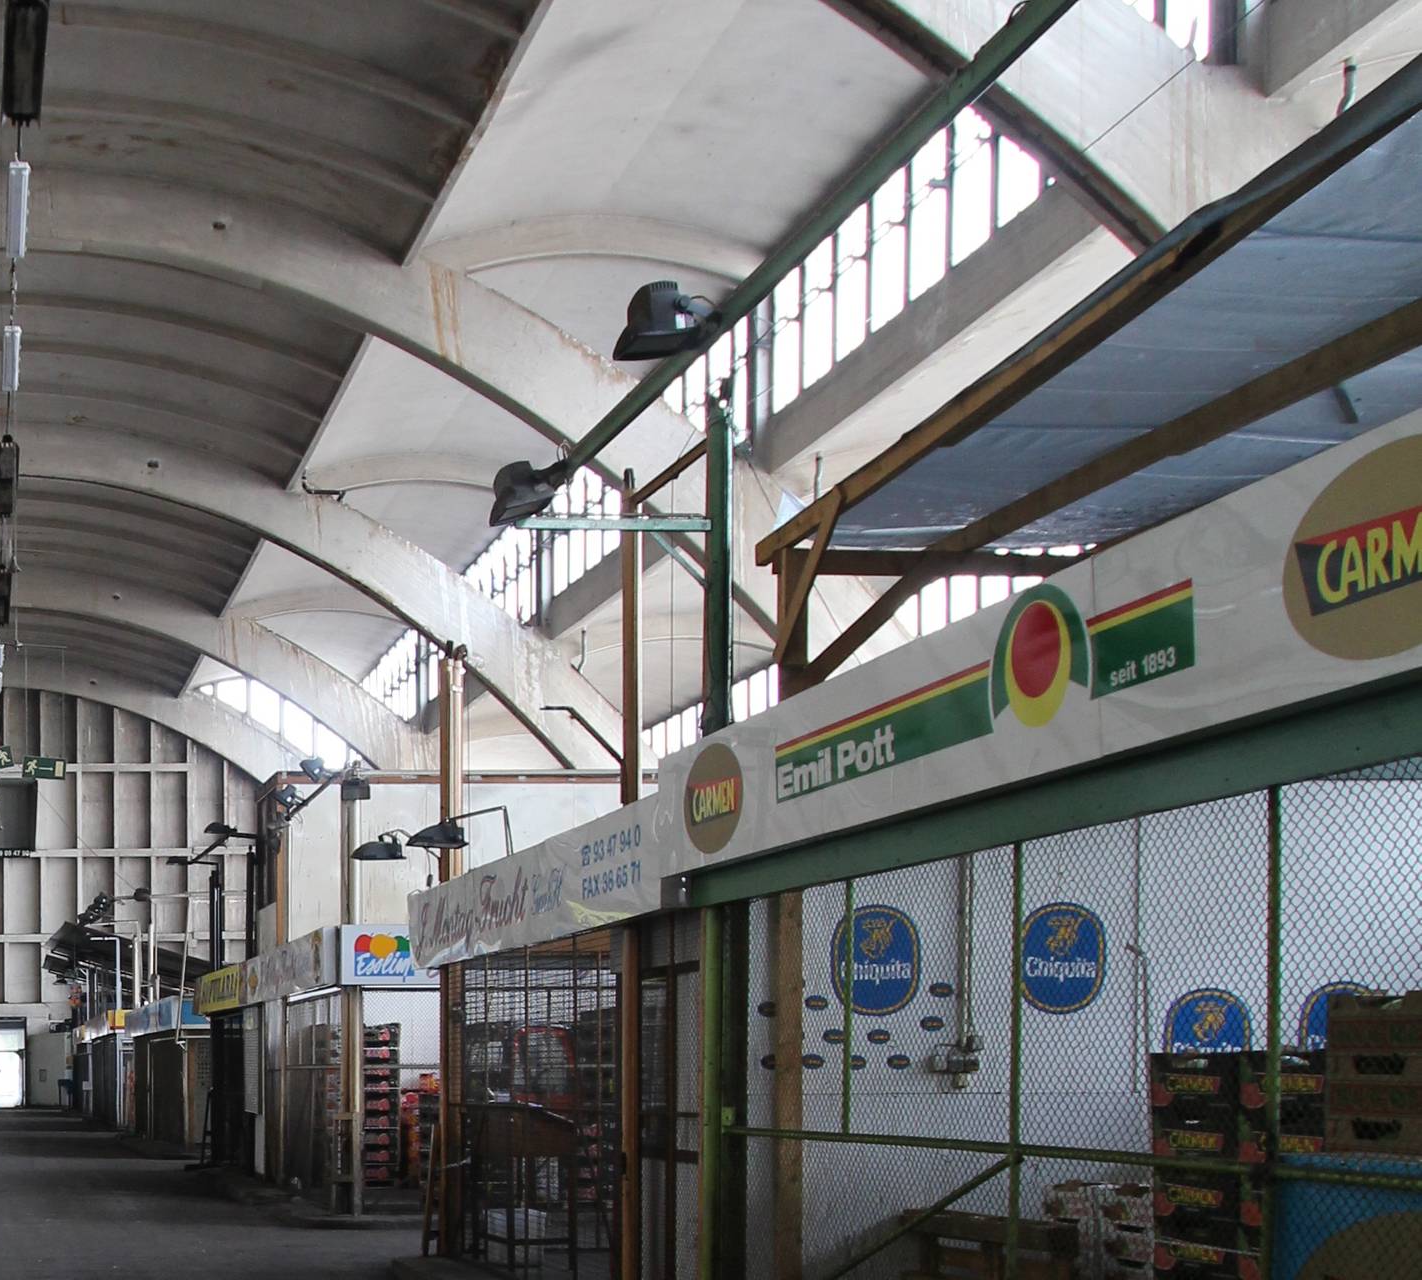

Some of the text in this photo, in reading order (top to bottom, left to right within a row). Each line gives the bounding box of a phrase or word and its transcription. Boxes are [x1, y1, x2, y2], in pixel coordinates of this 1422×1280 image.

[1109, 646, 1176, 688] seit 1893
[777, 724, 896, 800] Emil Pott
[692, 778, 736, 823] CARMEN
[593, 823, 641, 863] 93 47 94 0
[582, 873, 600, 900] FAX
[616, 864, 628, 889] 65
[630, 859, 641, 884] 71
[1026, 956, 1097, 982] Chiquita
